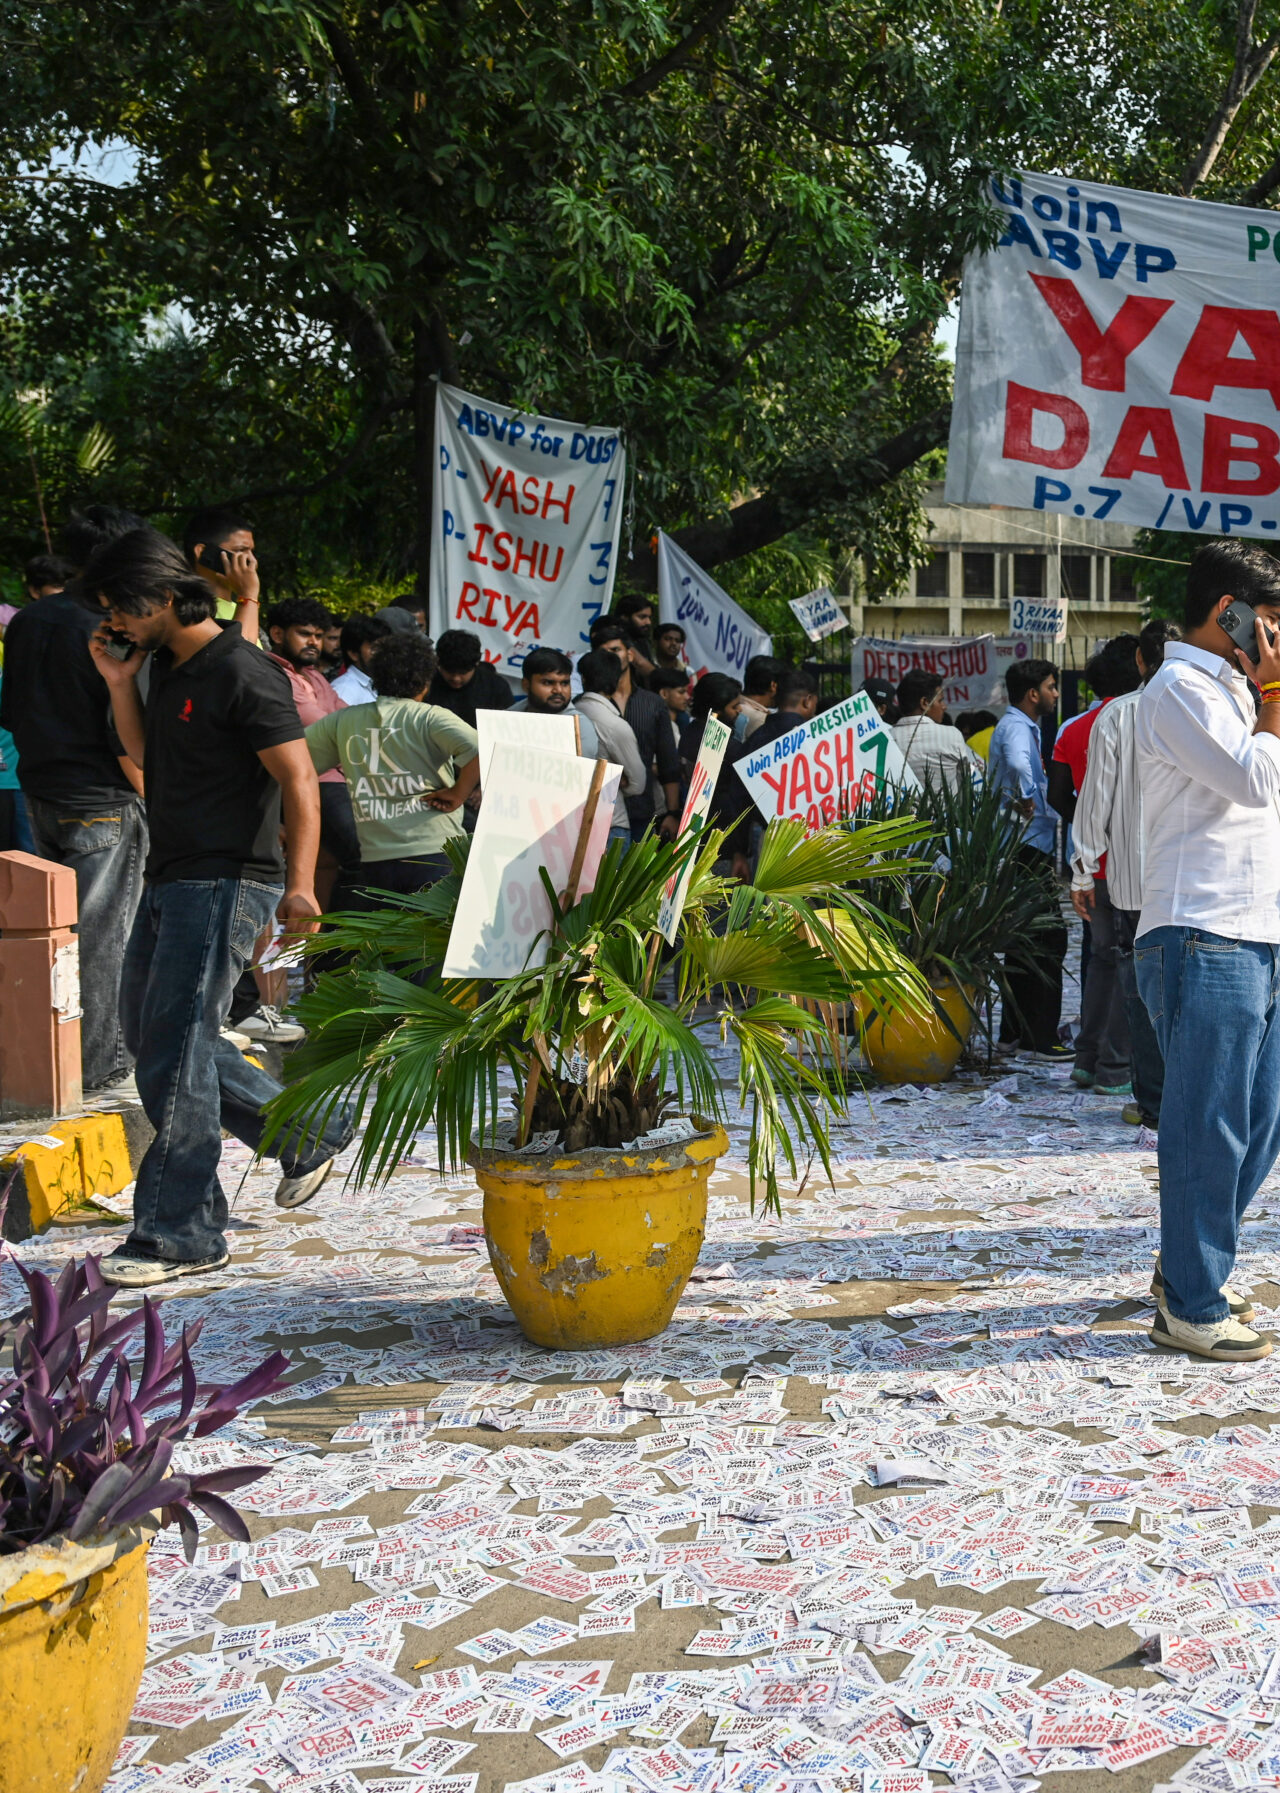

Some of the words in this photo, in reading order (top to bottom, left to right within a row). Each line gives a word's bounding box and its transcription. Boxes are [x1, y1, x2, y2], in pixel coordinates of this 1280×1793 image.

[999, 212, 1178, 283] ABVP
[457, 402, 526, 447] ABVP
[530, 423, 564, 457] for
[479, 459, 576, 525] YASH
[603, 478, 616, 523] 7
[467, 522, 565, 583] ISHU
[588, 541, 613, 586] 3
[455, 580, 542, 640] RIYA
[1013, 599, 1025, 630] 3
[1025, 605, 1064, 620] RIYAA
[857, 716, 880, 738] B.N.
[345, 727, 412, 776] CK
[859, 731, 889, 793] 7
[747, 754, 771, 779] Join
[761, 727, 855, 816] YASH
[594, 1574, 627, 1583] YASH
[221, 1629, 257, 1640] YASH
[586, 1616, 619, 1625] YASH
[698, 1636, 731, 1644] YASH
[558, 1661, 593, 1669] NSUI
[437, 1700, 473, 1717] YASH
[552, 1725, 590, 1741] YASH
